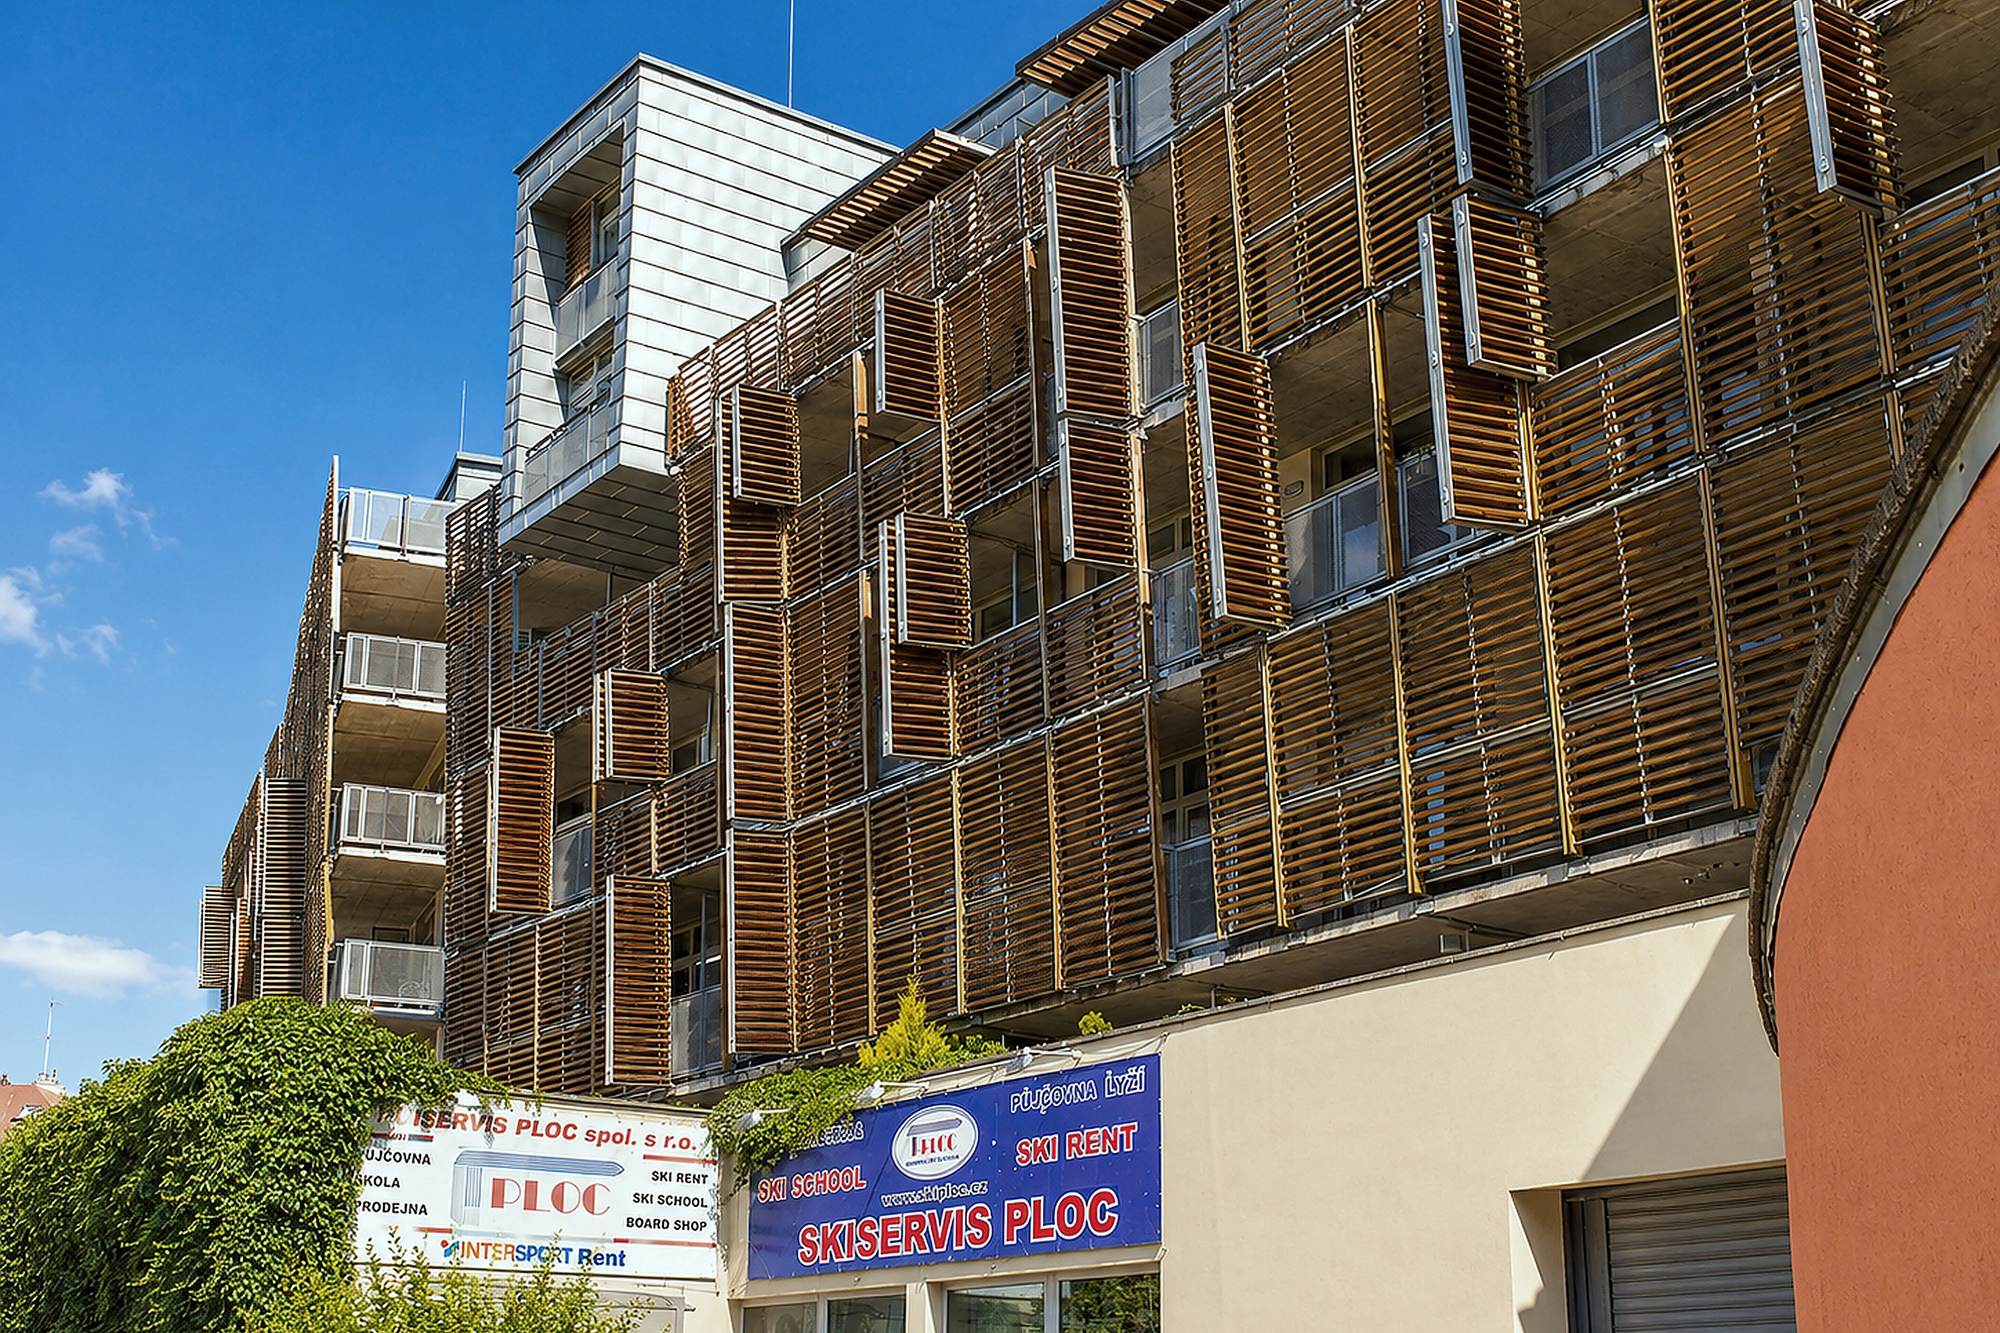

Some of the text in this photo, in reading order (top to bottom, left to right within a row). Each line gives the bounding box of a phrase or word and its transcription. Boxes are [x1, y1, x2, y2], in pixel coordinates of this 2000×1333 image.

[381, 1106, 697, 1151] ISERVIS PLOC spol. s r.o.
[1016, 1121, 1139, 1167] SKI RENT
[491, 1177, 611, 1216] PLOC
[651, 1170, 709, 1185] SKI RENT
[757, 1164, 867, 1203] SKI SCHOOL
[632, 1192, 708, 1209] SKI SCHOOL
[626, 1217, 708, 1232] BOARD SHOP
[797, 1187, 1120, 1267] SKISERVIS PLOC
[460, 1240, 627, 1267] INTERSPORT Rent
